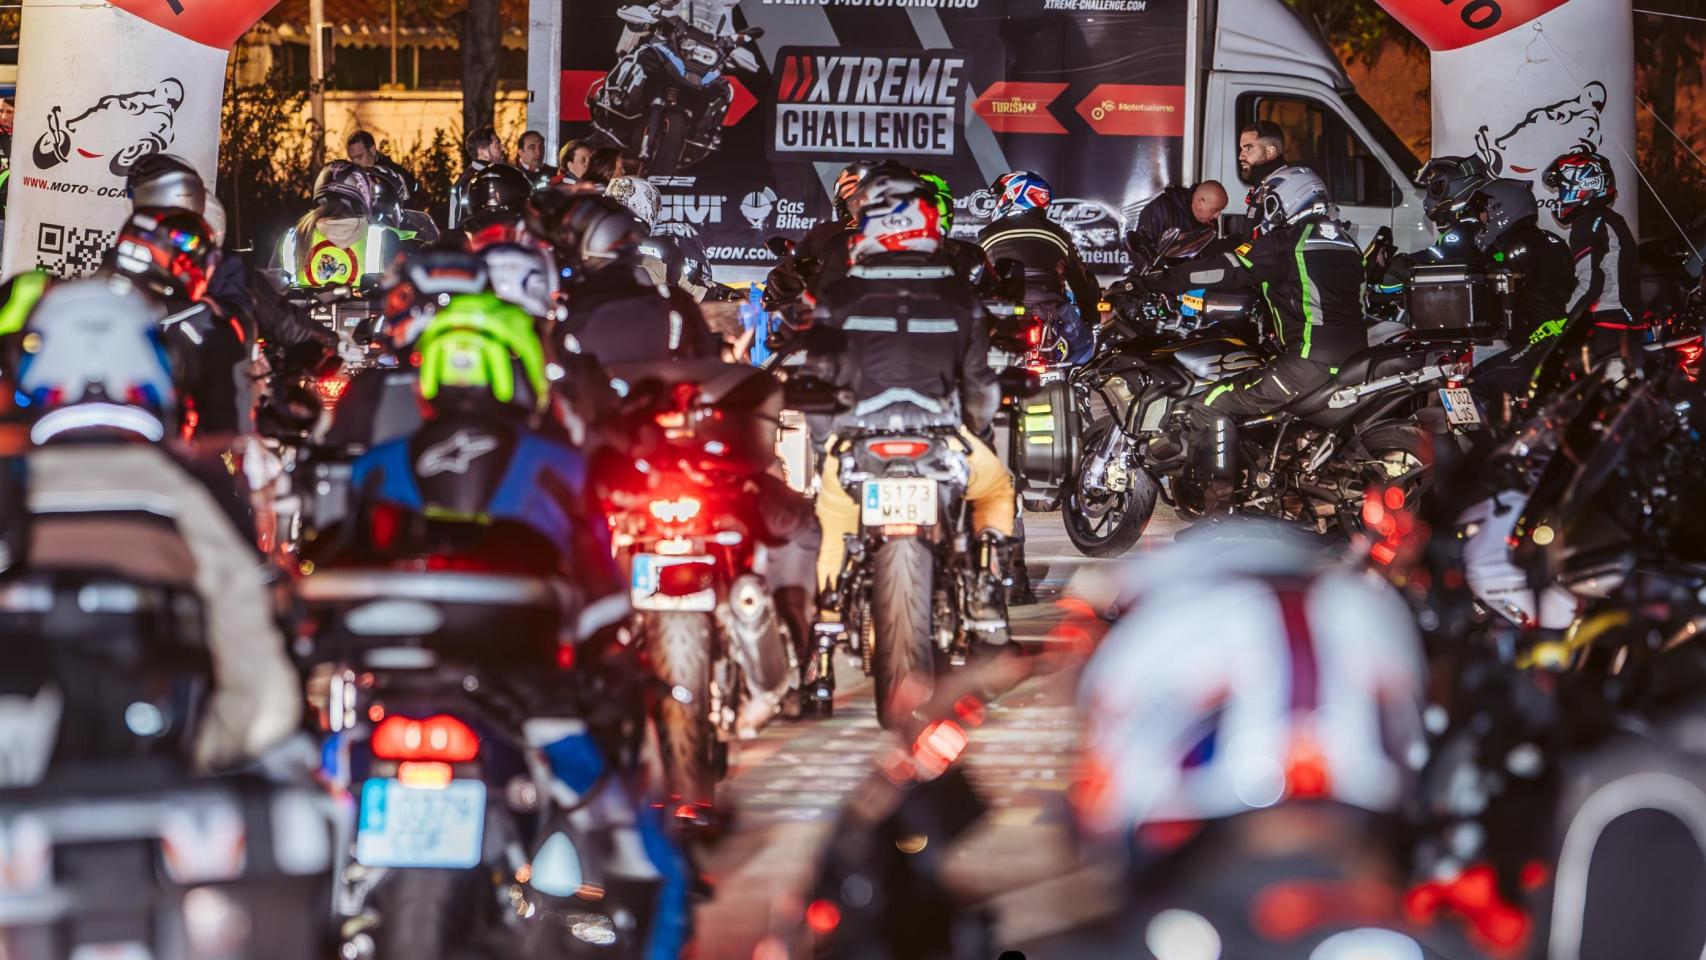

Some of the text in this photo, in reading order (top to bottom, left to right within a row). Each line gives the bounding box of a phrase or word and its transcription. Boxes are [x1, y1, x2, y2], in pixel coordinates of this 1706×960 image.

[1043, 0, 1146, 11] XTREME-CHALLENGE.COM
[807, 56, 964, 105] XTREME
[1118, 103, 1175, 113] Mototurismo
[782, 110, 947, 150] CHALLENGE
[776, 199, 805, 214] Gas
[1047, 203, 1100, 219] HJC
[775, 213, 818, 230] Biker
[1446, 390, 1473, 405] 7002
[1453, 407, 1475, 422] LJS
[882, 485, 931, 502] 5173
[881, 503, 918, 521] MKB
